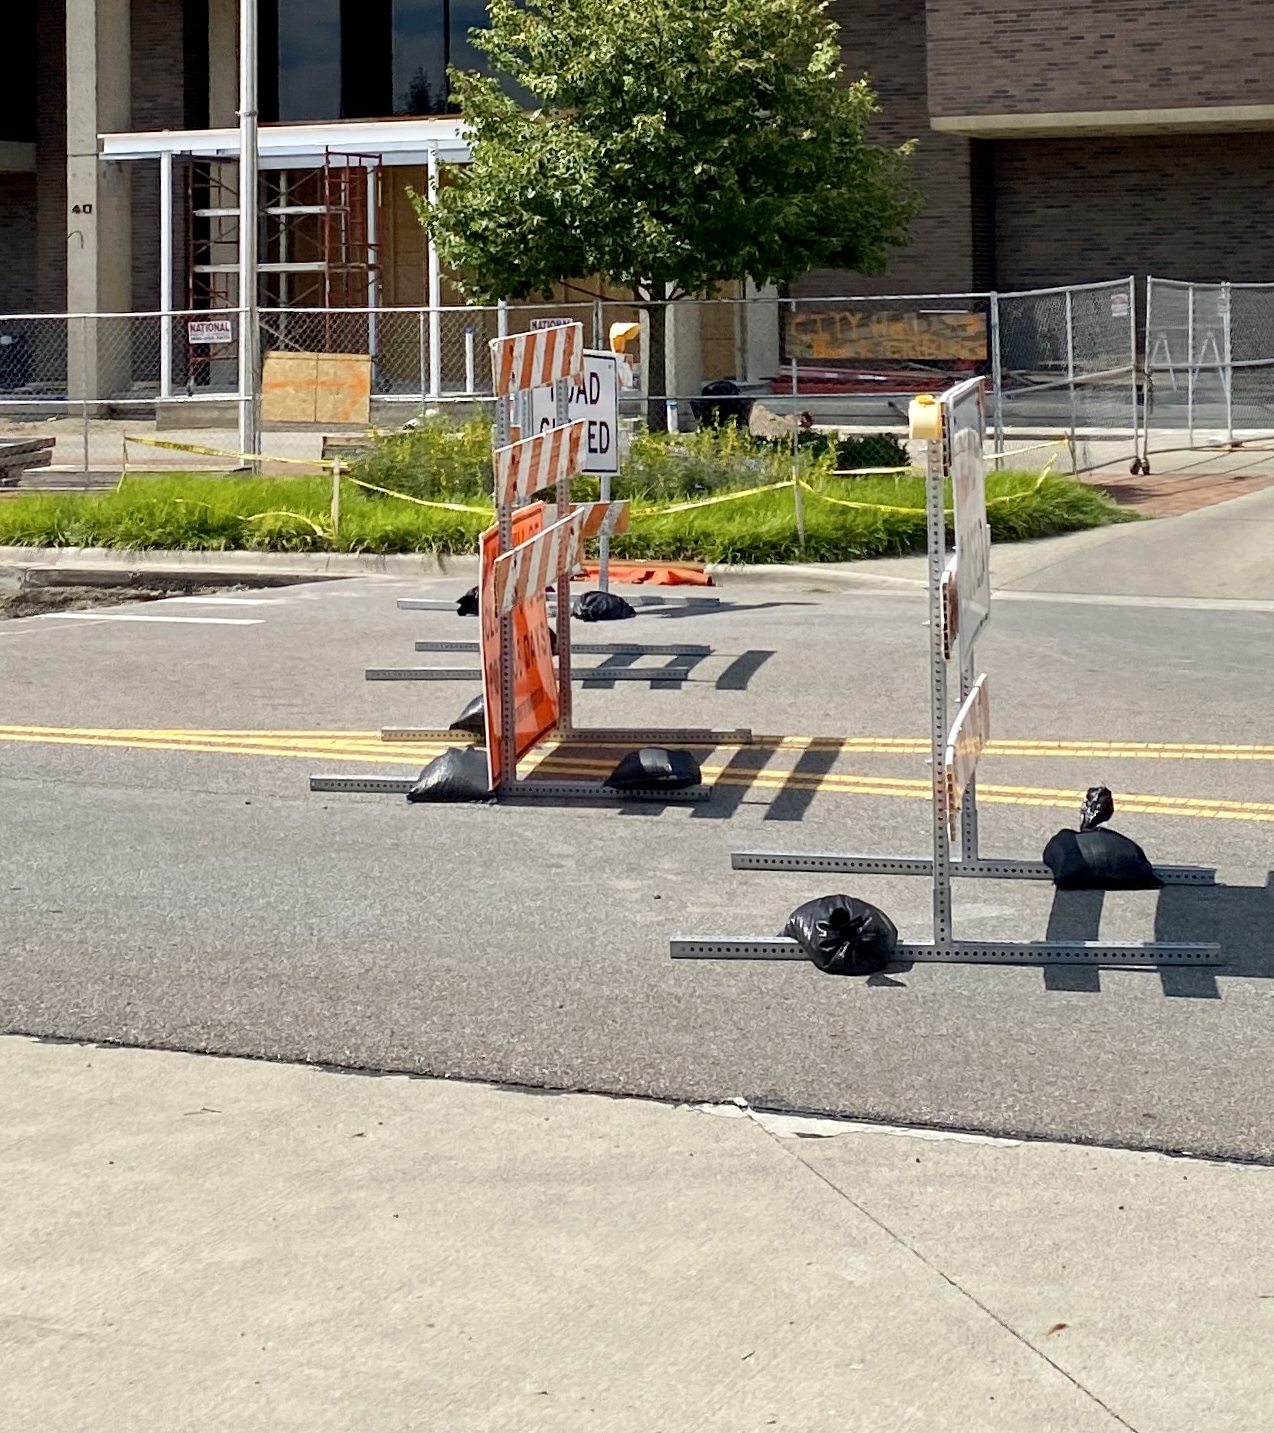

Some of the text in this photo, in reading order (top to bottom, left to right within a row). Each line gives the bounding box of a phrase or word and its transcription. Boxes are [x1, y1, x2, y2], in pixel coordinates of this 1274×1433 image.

[71, 204, 92, 214] 40
[190, 322, 230, 332] NATIONAL
[791, 311, 863, 339] CITY
[550, 372, 601, 405] AD
